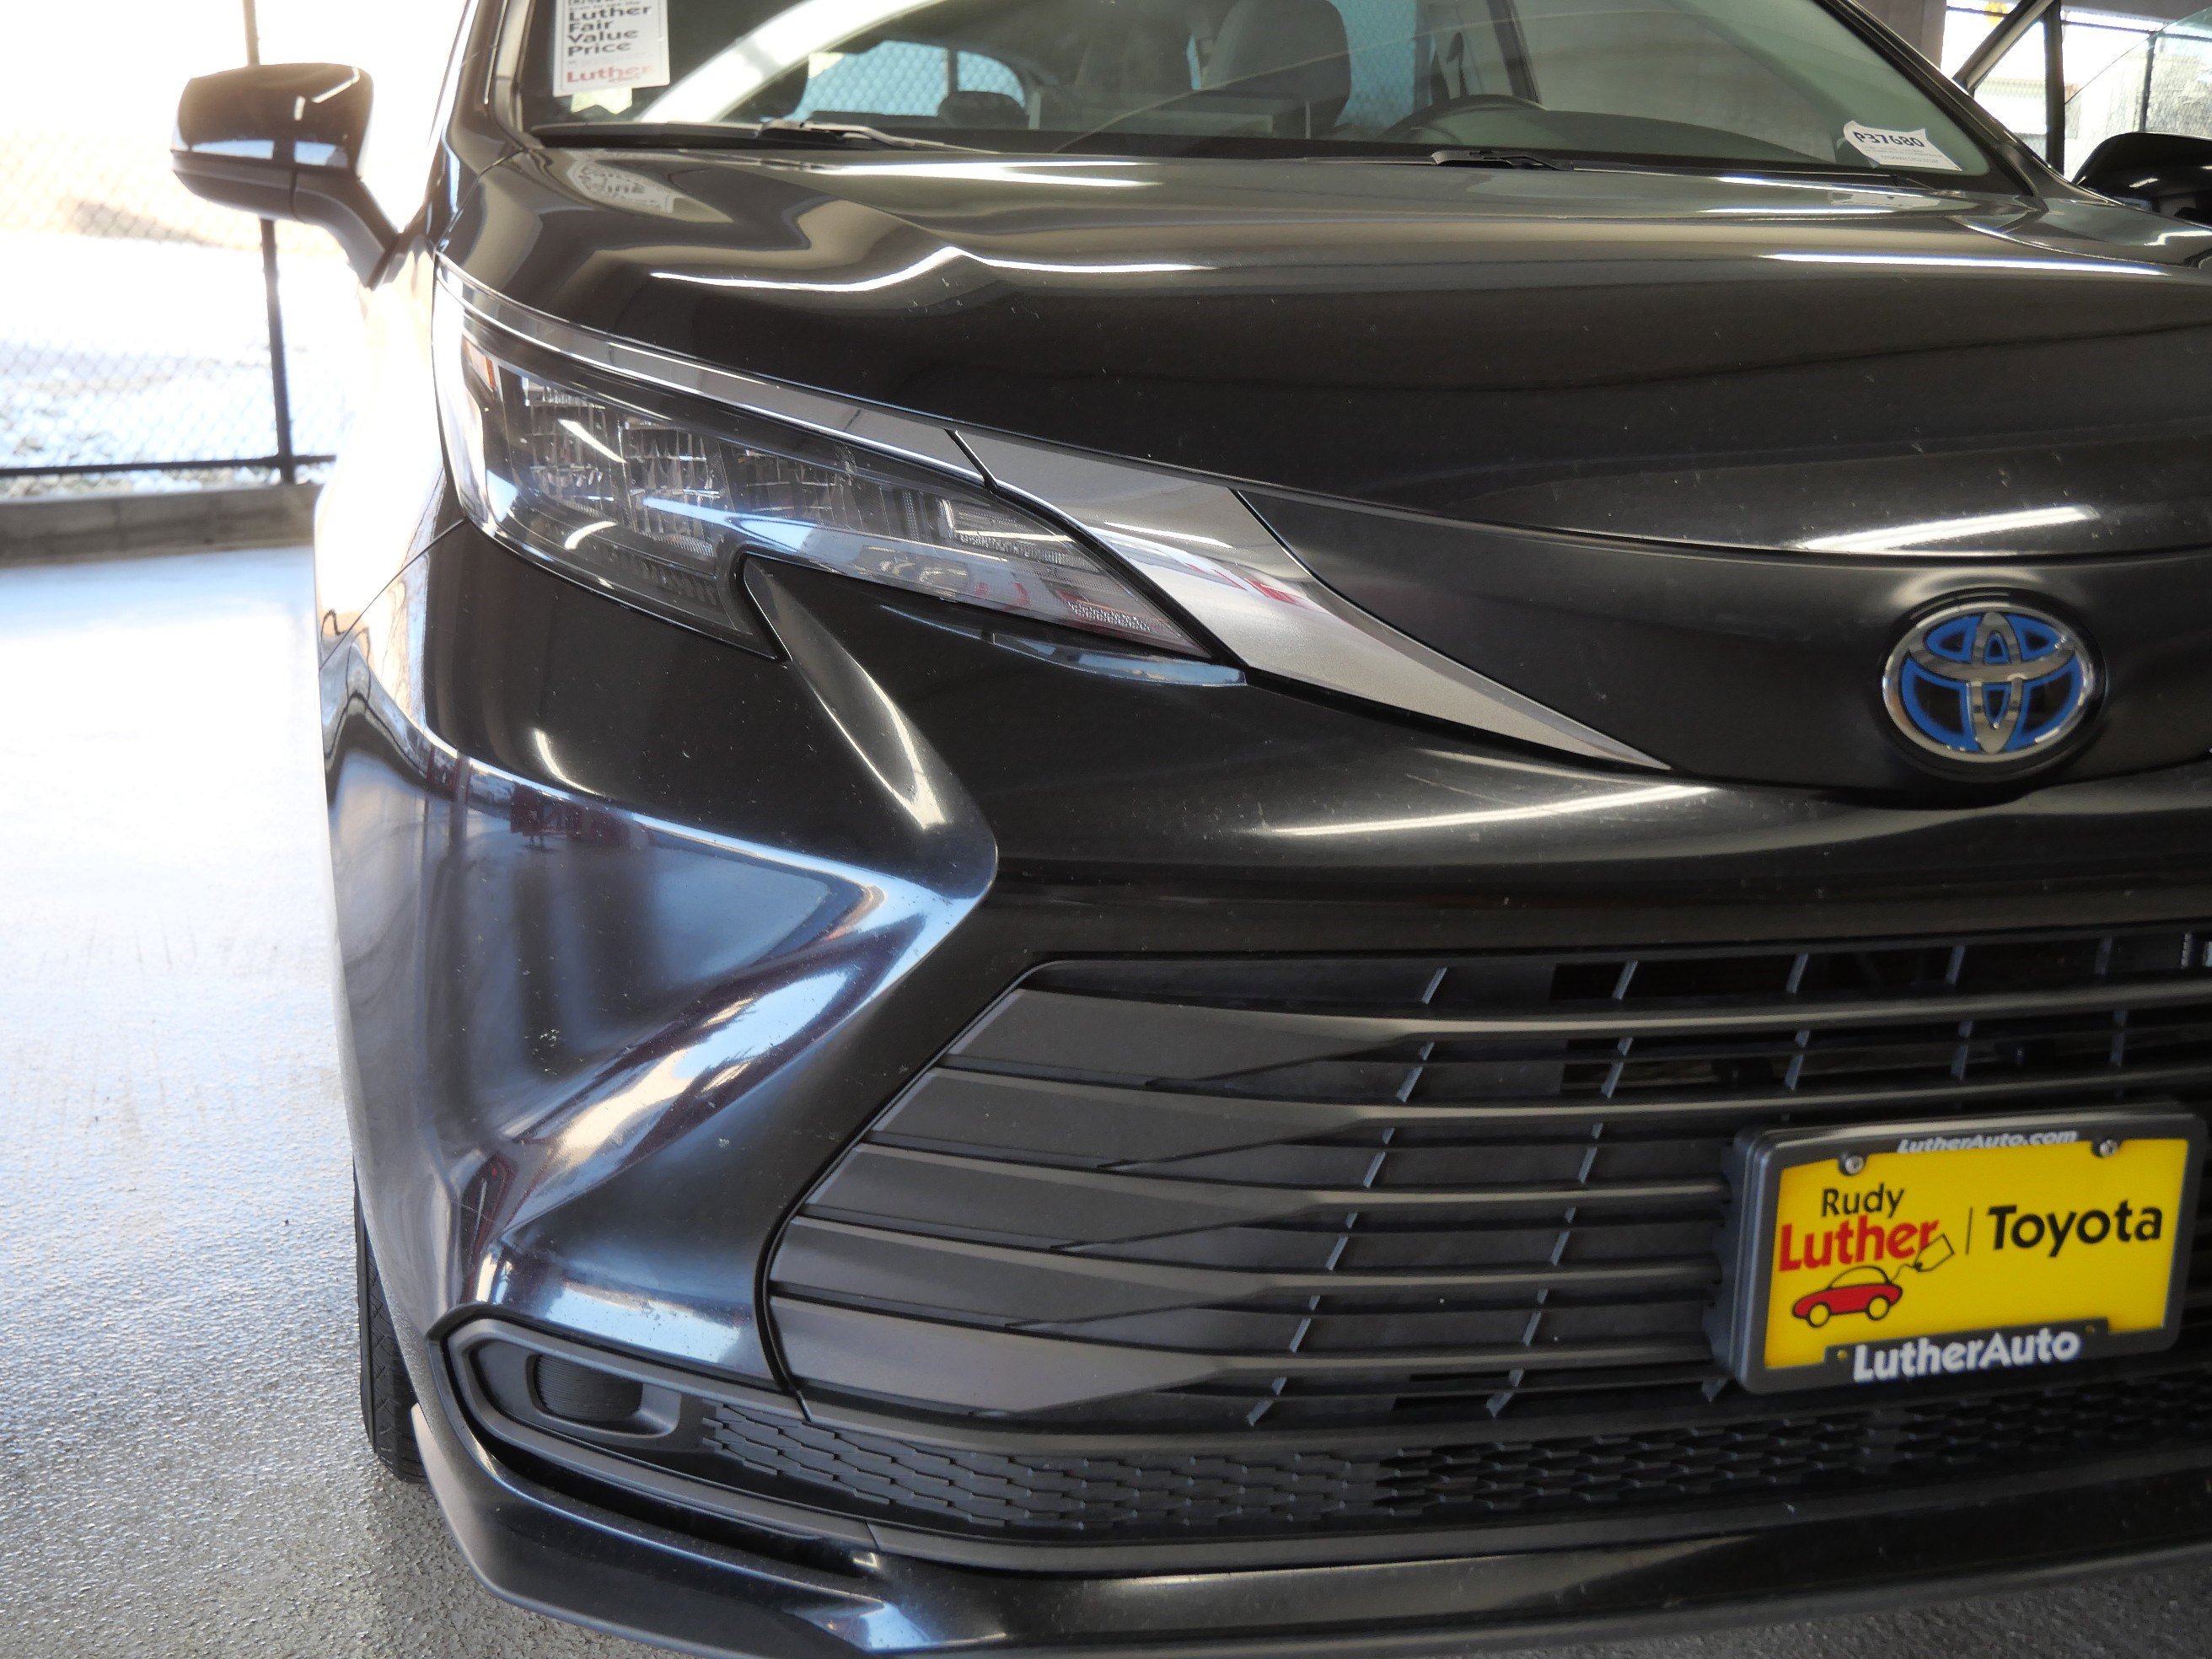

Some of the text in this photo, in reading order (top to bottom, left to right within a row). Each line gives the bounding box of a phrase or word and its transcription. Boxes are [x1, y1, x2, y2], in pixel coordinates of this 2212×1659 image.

[568, 6, 652, 22] Luther
[568, 20, 613, 33] Fair
[567, 30, 638, 43] Value
[567, 42, 631, 56] Price
[566, 65, 651, 83] Luther
[1853, 131, 1925, 148] P37680
[1897, 1130, 2078, 1154] LutherAuto.com
[1821, 1183, 1905, 1219] Rudy
[1988, 1200, 2163, 1258] Toyota
[1779, 1213, 1939, 1272] Luther
[1853, 1327, 2081, 1382] LutherAuto
